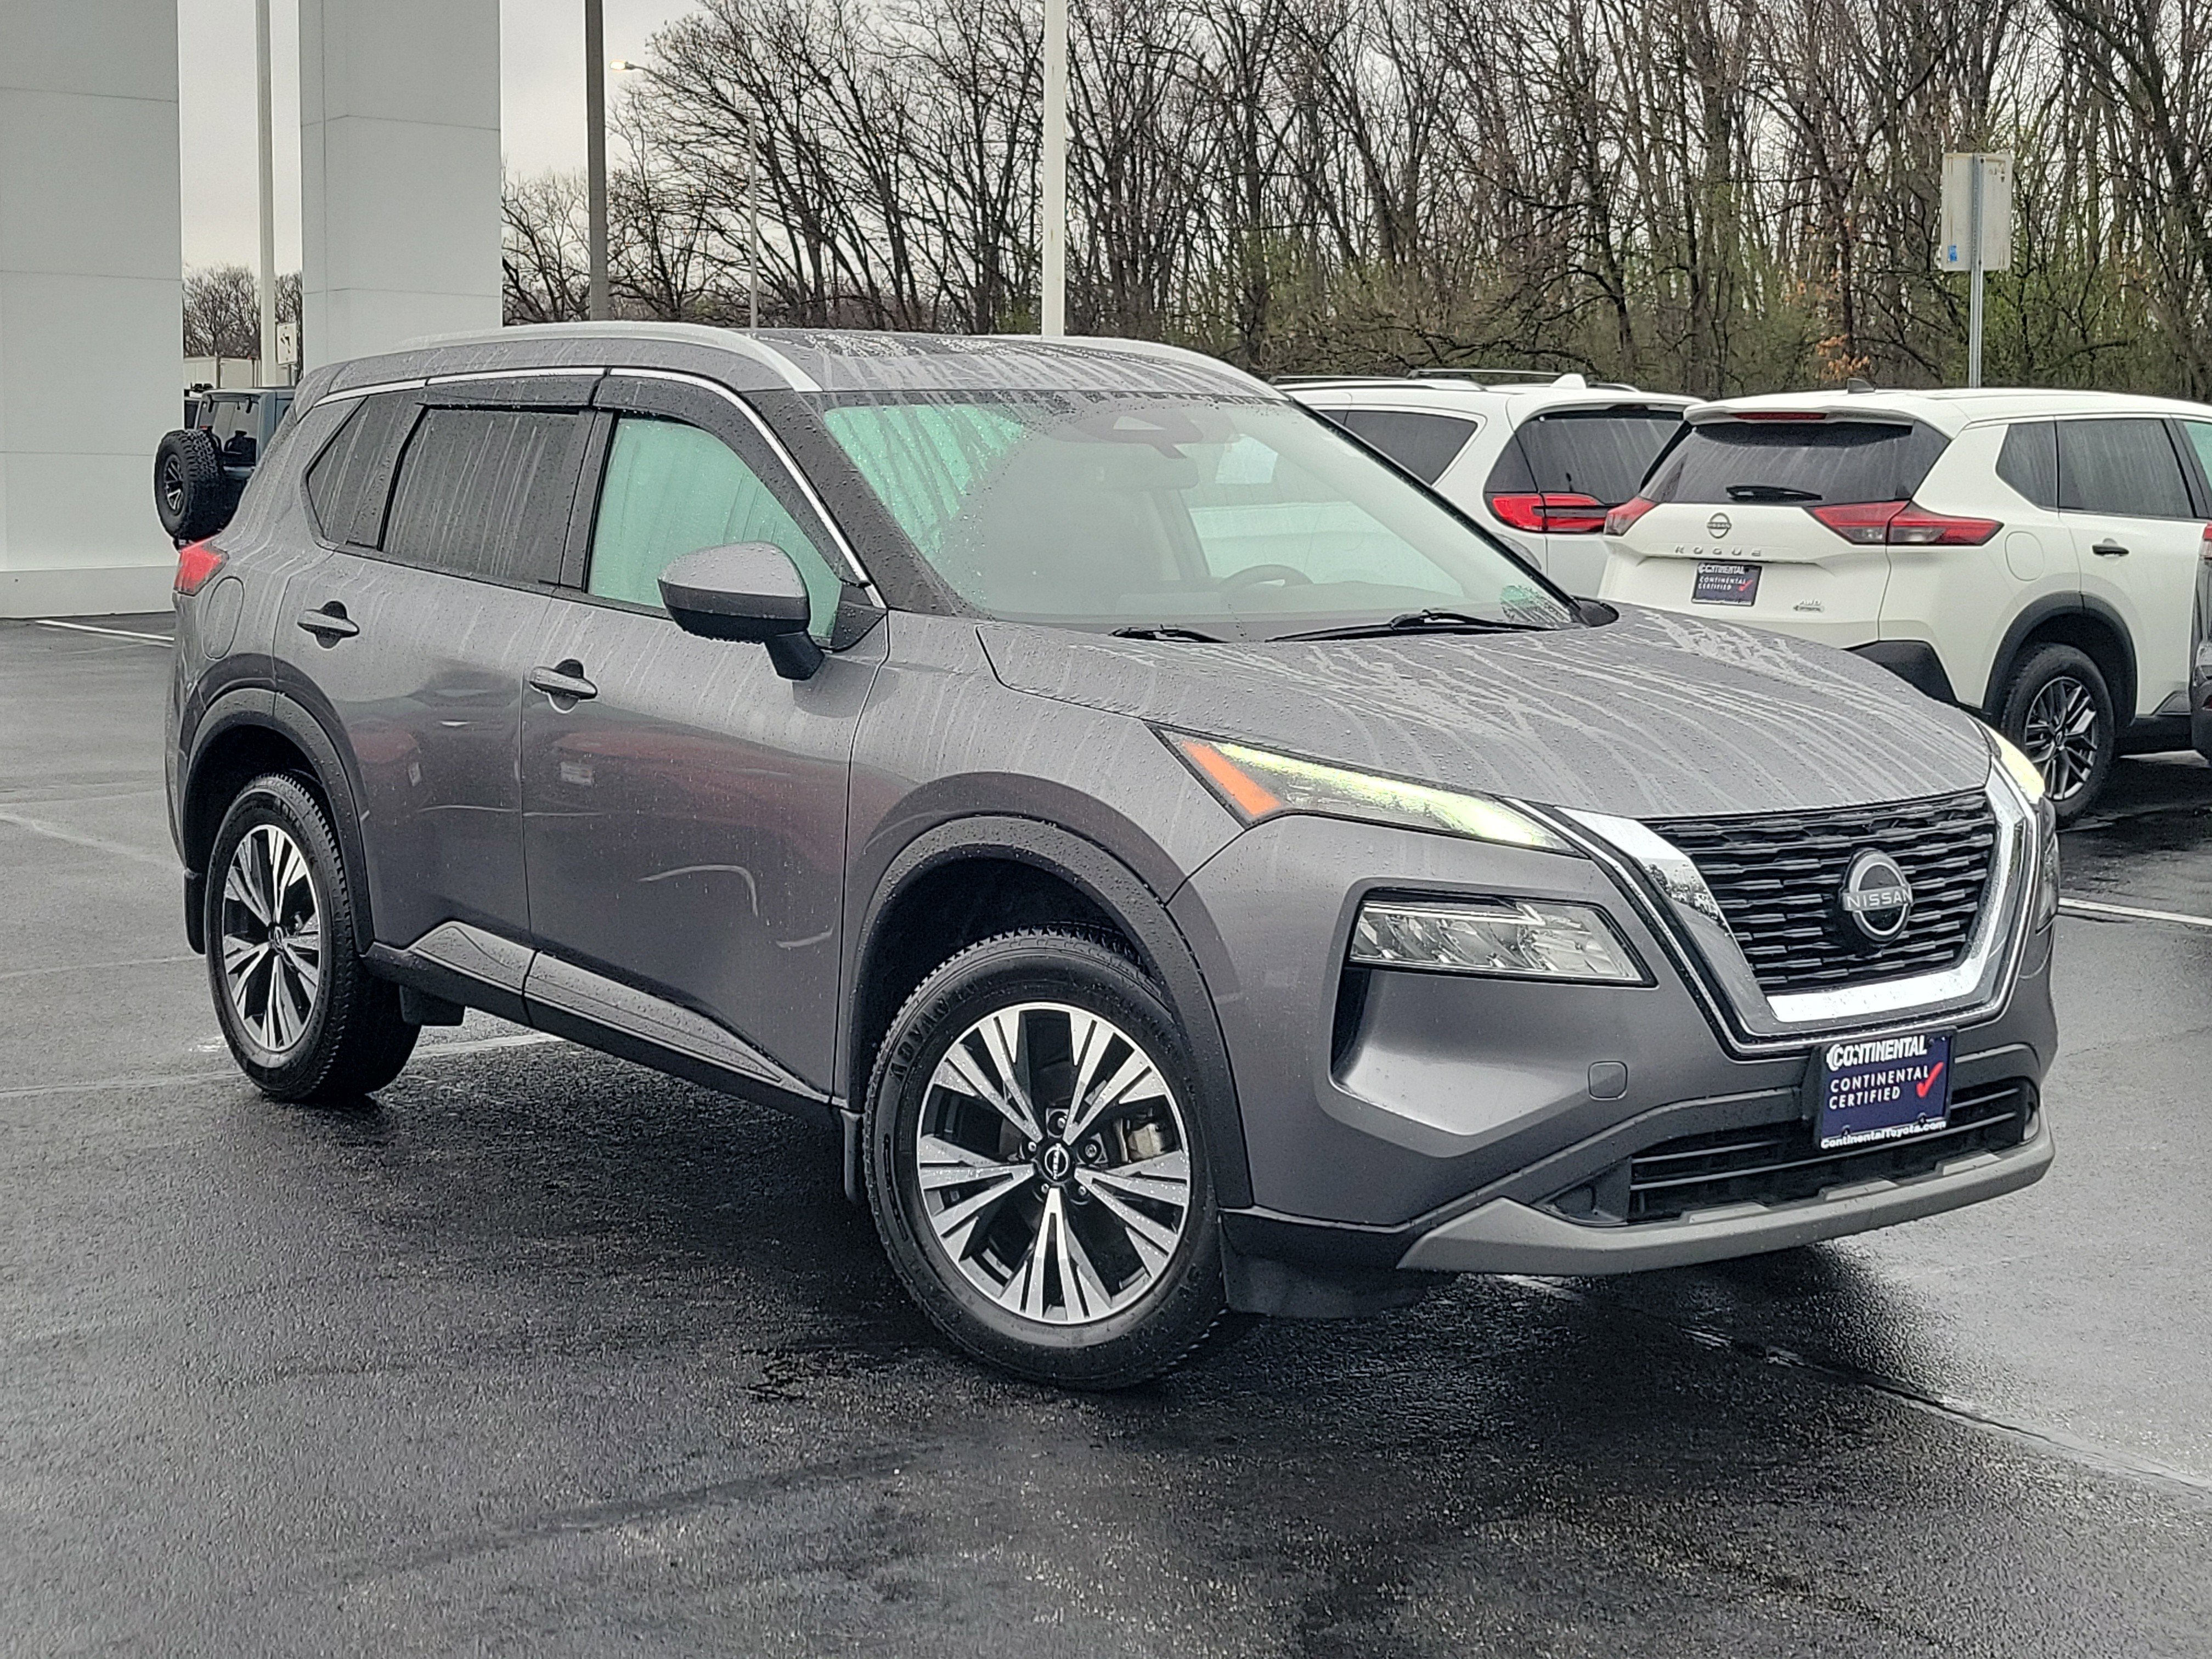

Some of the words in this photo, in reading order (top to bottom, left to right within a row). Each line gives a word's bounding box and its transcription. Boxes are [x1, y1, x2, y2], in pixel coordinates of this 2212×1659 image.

[1846, 887, 1913, 908] NISSAN
[1830, 1065, 1929, 1093] CONTINENTAL
[1829, 1086, 1901, 1110] CERTIFIED
[1820, 1121, 1947, 1149] ContinentalToyota.com
